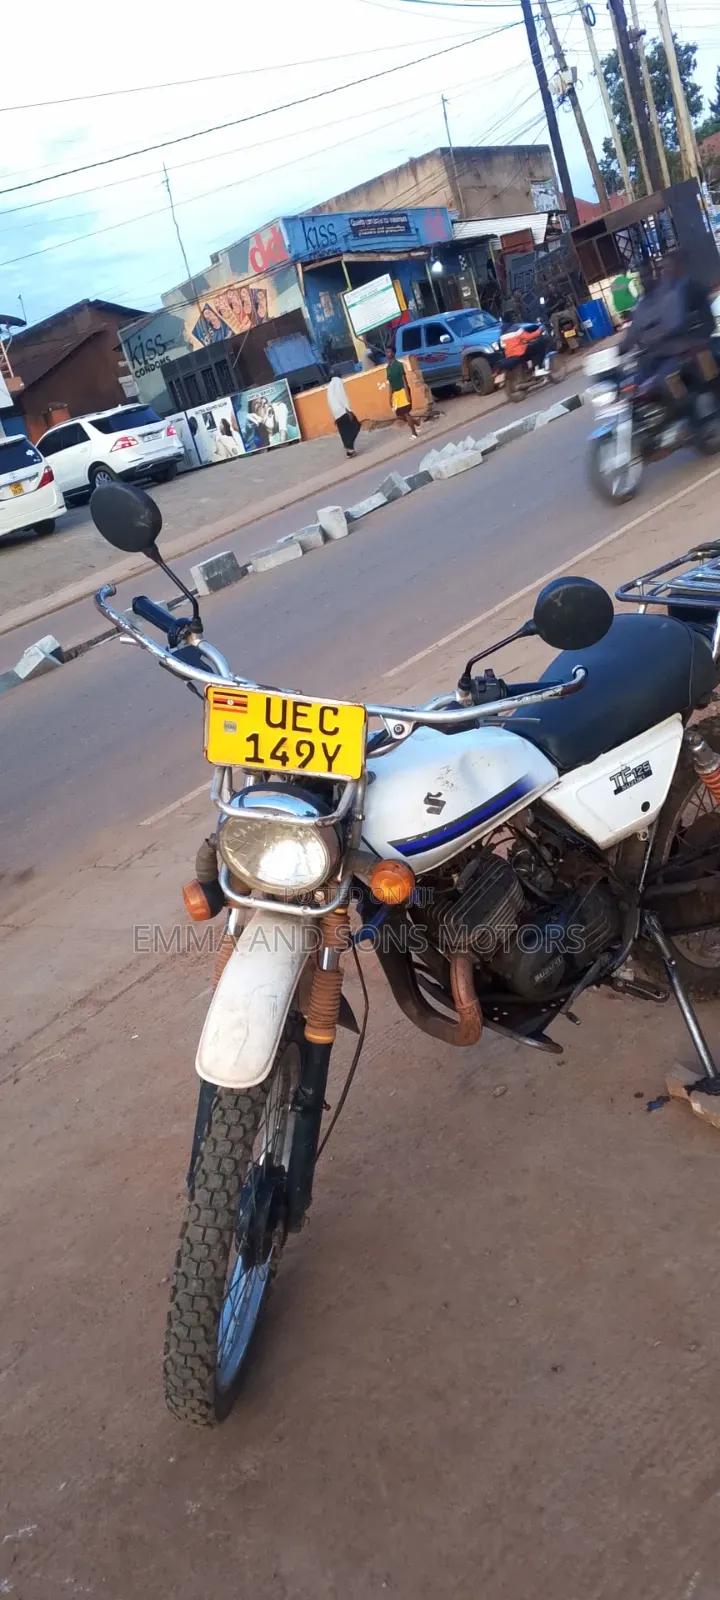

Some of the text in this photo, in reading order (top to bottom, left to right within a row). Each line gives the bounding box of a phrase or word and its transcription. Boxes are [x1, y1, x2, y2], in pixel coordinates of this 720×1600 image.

[300, 216, 338, 251] kiss
[124, 334, 166, 369] kiss
[135, 355, 171, 378] CONDOMS
[265, 697, 339, 736] UEC
[245, 733, 342, 772] 149Y
